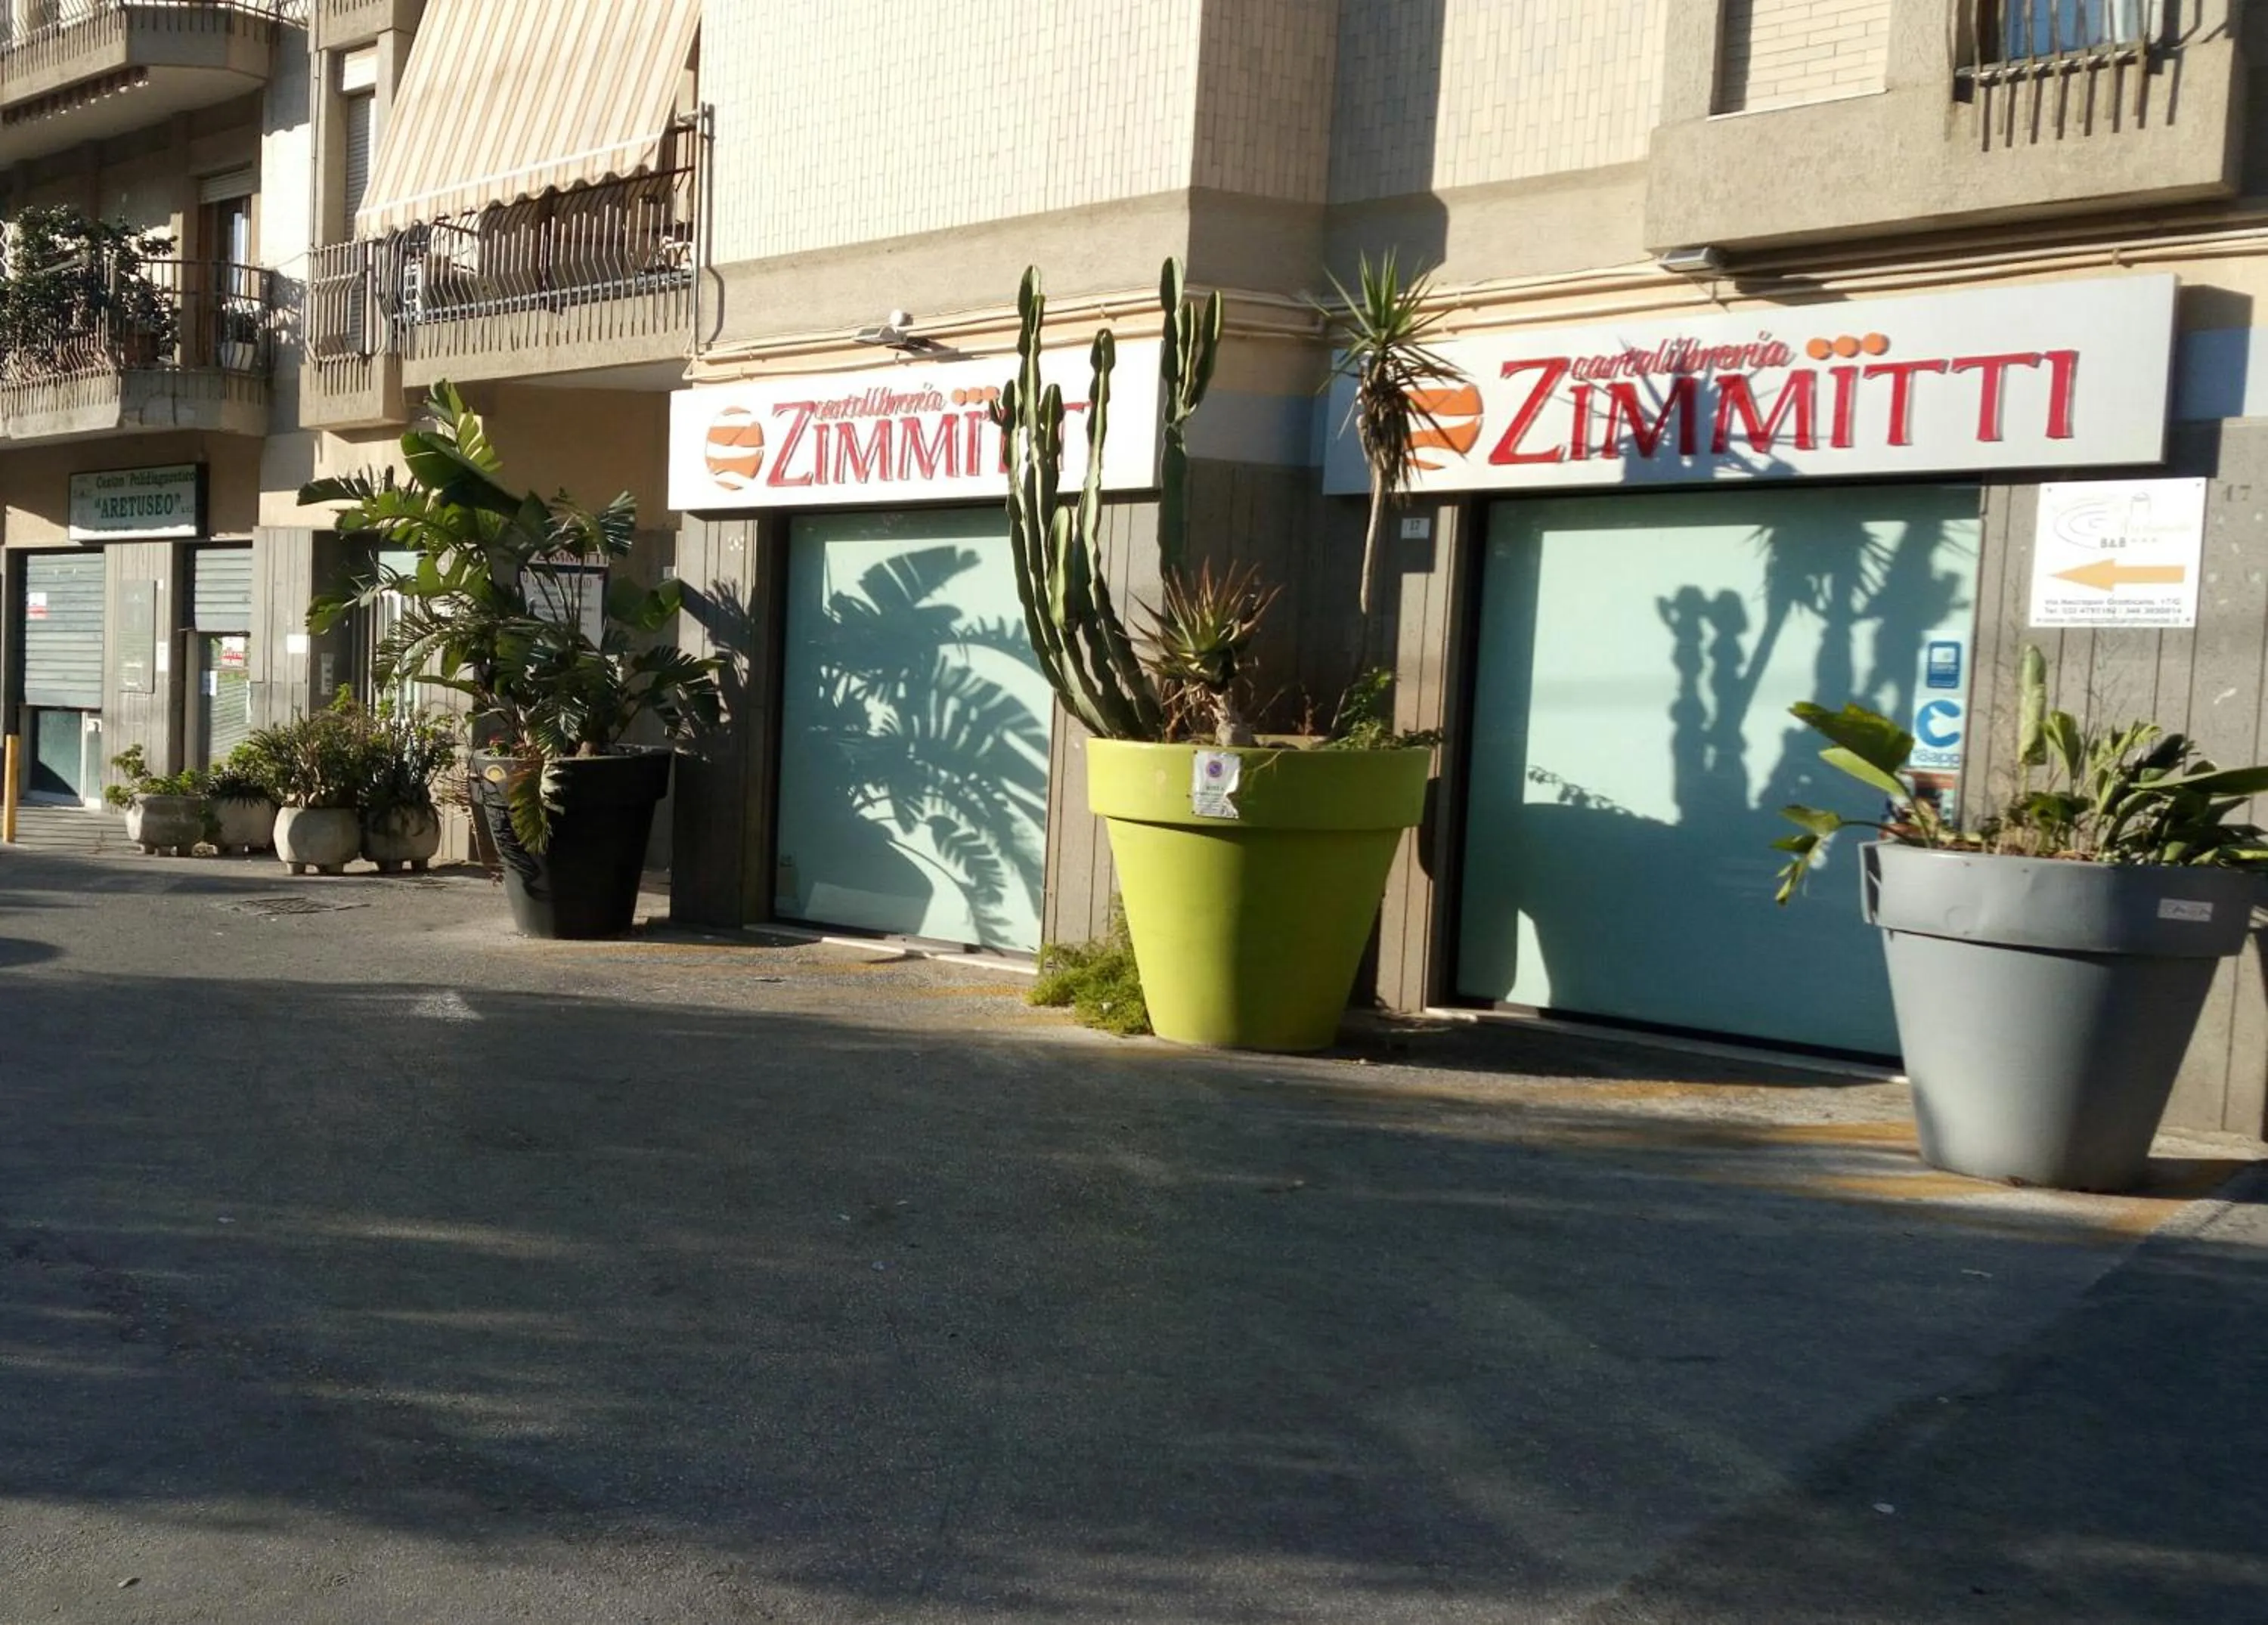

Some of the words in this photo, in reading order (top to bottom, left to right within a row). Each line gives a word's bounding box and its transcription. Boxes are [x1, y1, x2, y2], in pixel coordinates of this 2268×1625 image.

[1572, 330, 1796, 379] cartolibreria
[766, 399, 1101, 488] ZIMMI
[1487, 349, 2078, 466] ZIMMITTI
